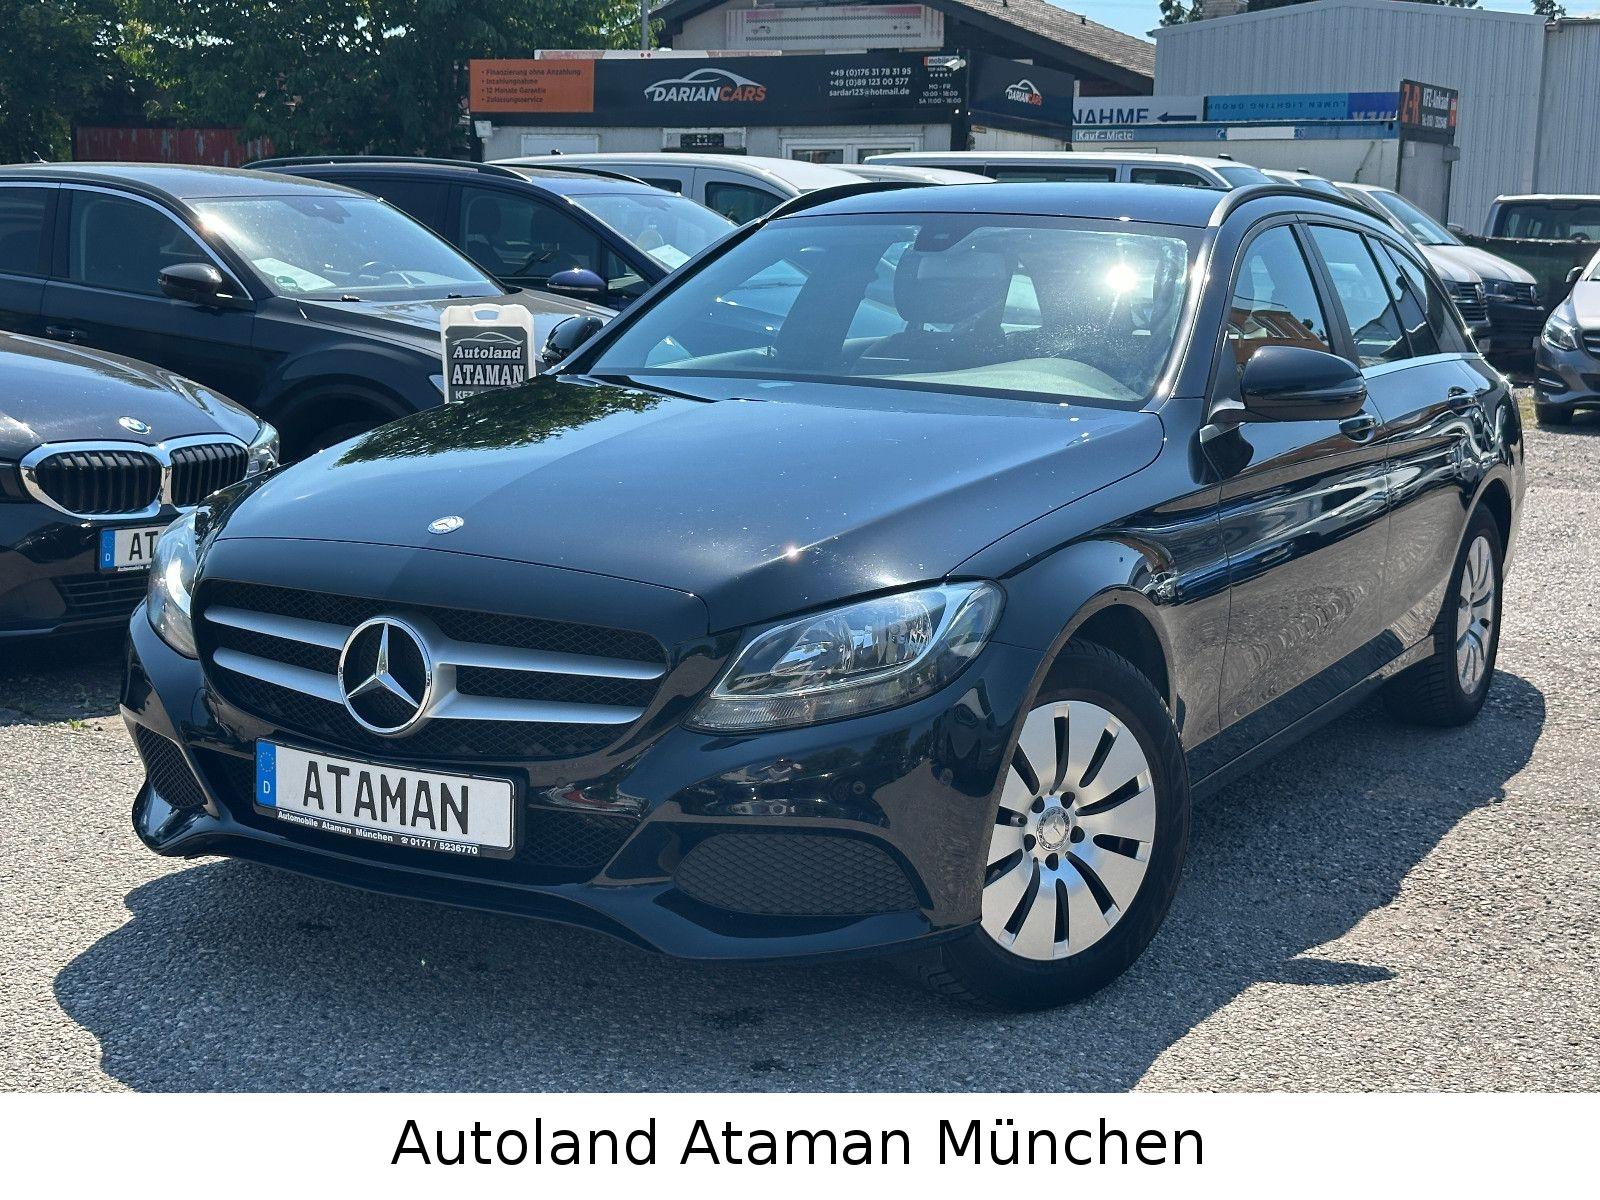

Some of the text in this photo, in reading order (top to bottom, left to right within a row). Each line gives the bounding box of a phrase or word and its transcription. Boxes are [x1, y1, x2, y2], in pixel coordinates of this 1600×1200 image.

[486, 68, 528, 77] Finanzierung
[546, 68, 581, 76] Anzahlung
[846, 68, 870, 77] (0)176
[871, 68, 879, 76] 31
[902, 67, 912, 75] 95
[830, 79, 845, 87] +49
[868, 78, 880, 86] 123
[653, 85, 767, 101] DARIANCARS
[829, 87, 910, 97] sardar123@hotmail.de
[452, 346, 522, 360] Autoland
[452, 364, 525, 386] ATAMAN
[105, 552, 111, 562] D
[263, 780, 271, 794] D
[303, 760, 469, 835] ATAMAN
[278, 810, 318, 828] Automobile
[322, 821, 352, 835] Ataman
[355, 828, 393, 842] München
[410, 837, 431, 848] 0171
[440, 842, 478, 855] 5236770
